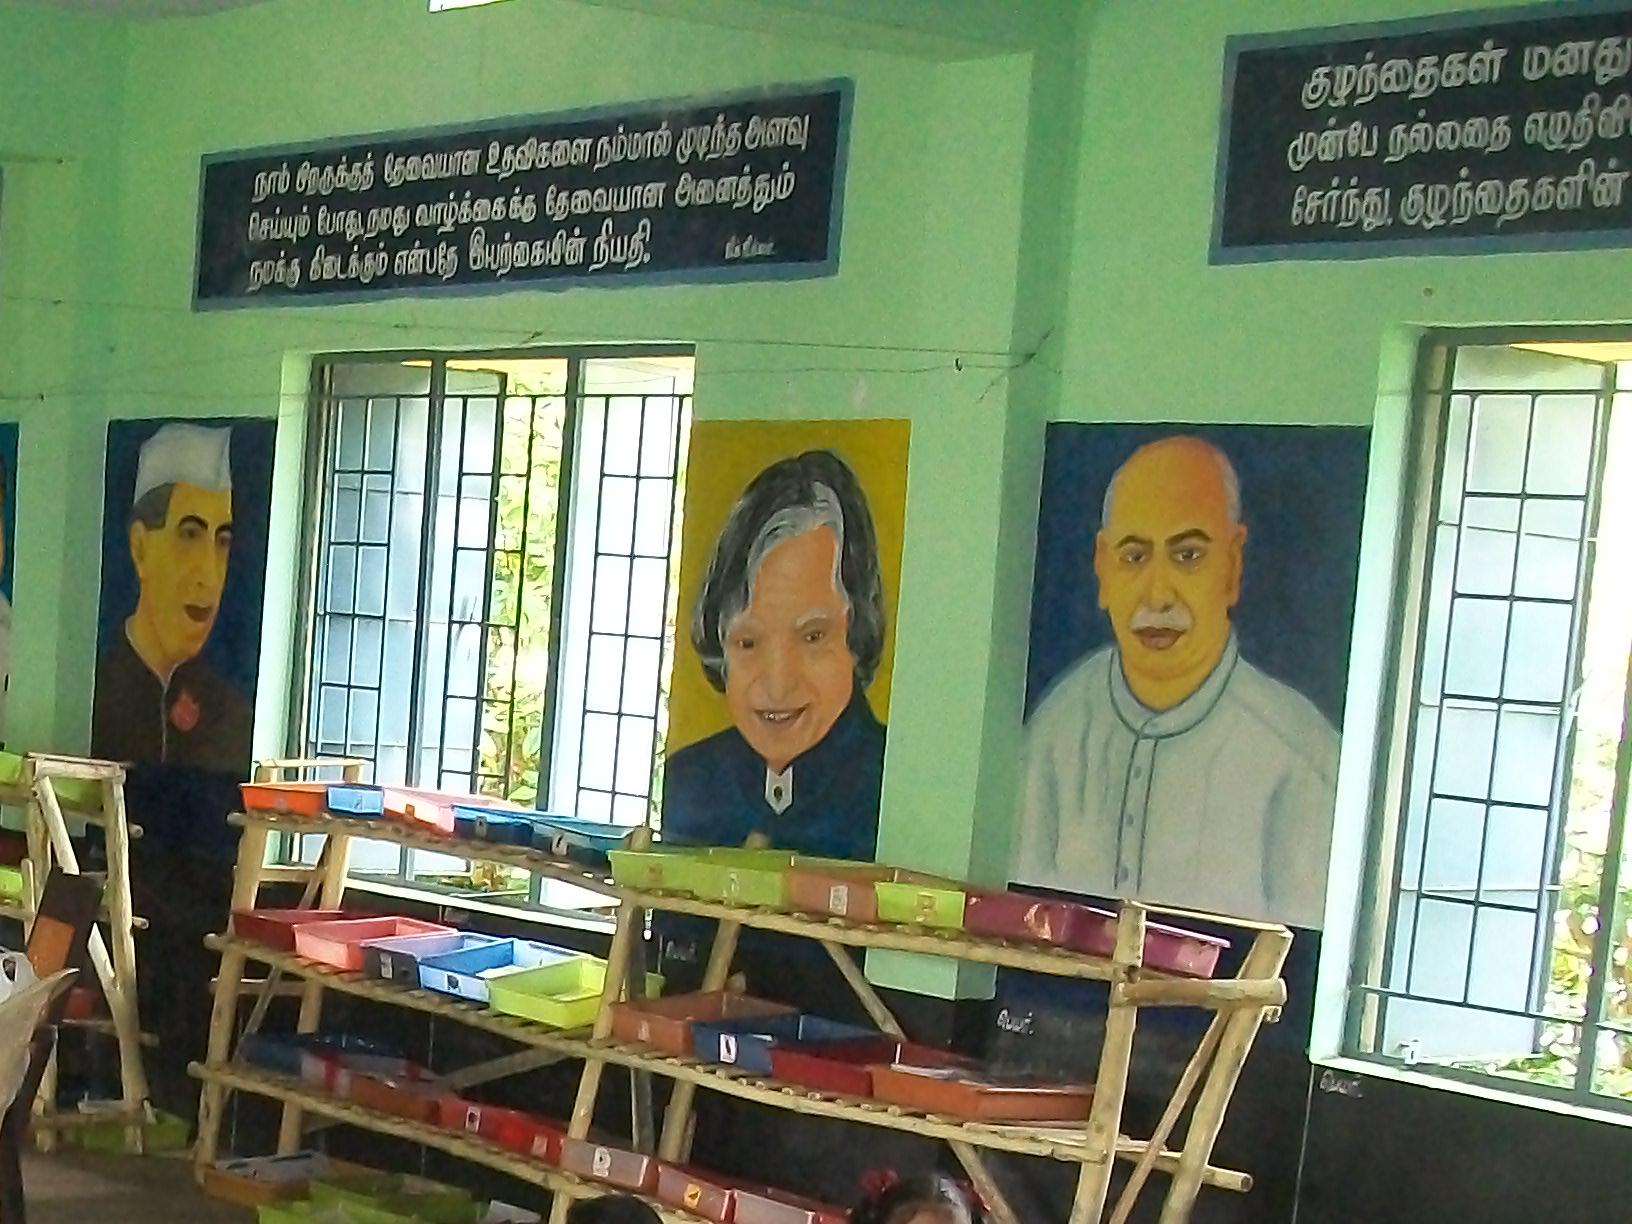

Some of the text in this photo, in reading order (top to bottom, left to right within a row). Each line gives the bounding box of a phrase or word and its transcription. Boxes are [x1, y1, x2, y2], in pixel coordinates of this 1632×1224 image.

[1301, 39, 1508, 109] குழந்தைகள்
[252, 161, 290, 203] நாம்
[384, 147, 482, 188] தேவையான
[486, 137, 593, 182] உதவிகளை
[593, 120, 673, 172] நம்மால்
[676, 113, 743, 165] முடிந்த
[744, 114, 810, 151] அளவு
[1287, 92, 1632, 172] முன்பே நல்லதை எழுதிவி
[248, 205, 310, 243] செய்யும்
[363, 205, 411, 238] நமது
[545, 182, 667, 221] தேவையான
[675, 161, 795, 214] அனைத்தும்
[1399, 157, 1630, 230] குழந்தைகளின்
[246, 250, 301, 293] நமக்கு
[309, 242, 388, 284] கிடைக்கும்
[394, 240, 458, 281] என்பதே
[469, 225, 588, 277] இயற்கையின்
